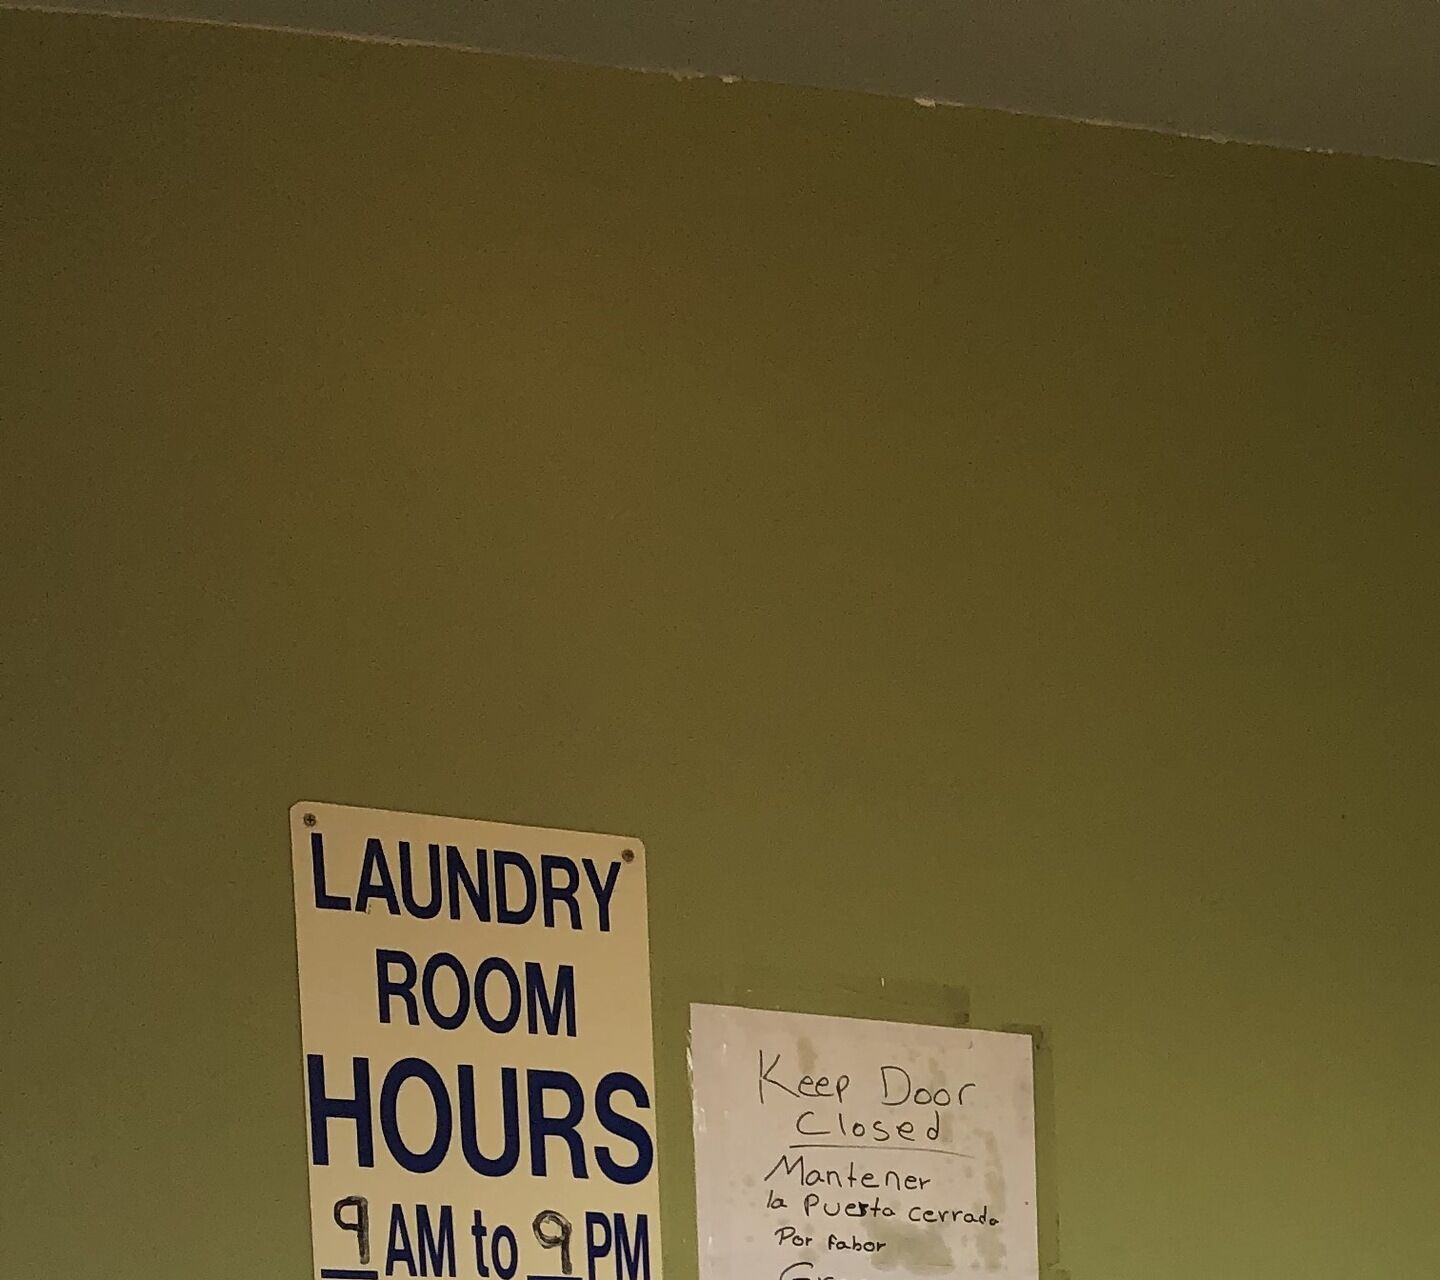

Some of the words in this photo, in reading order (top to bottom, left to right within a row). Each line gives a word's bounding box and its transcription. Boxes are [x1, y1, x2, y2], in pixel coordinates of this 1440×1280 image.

[310, 832, 622, 932] LAUNDRY
[376, 948, 576, 1037] ROOM
[759, 1050, 850, 1104] Keep
[881, 1066, 976, 1106] Door
[307, 1053, 653, 1185] HOURS
[796, 1110, 940, 1141] Closed
[764, 1155, 931, 1190] Mantener
[333, 1195, 370, 1264] 9
[385, 1203, 456, 1278] AM
[471, 1209, 518, 1280] to
[532, 1209, 573, 1274] 9
[775, 1227, 813, 1247] Por
